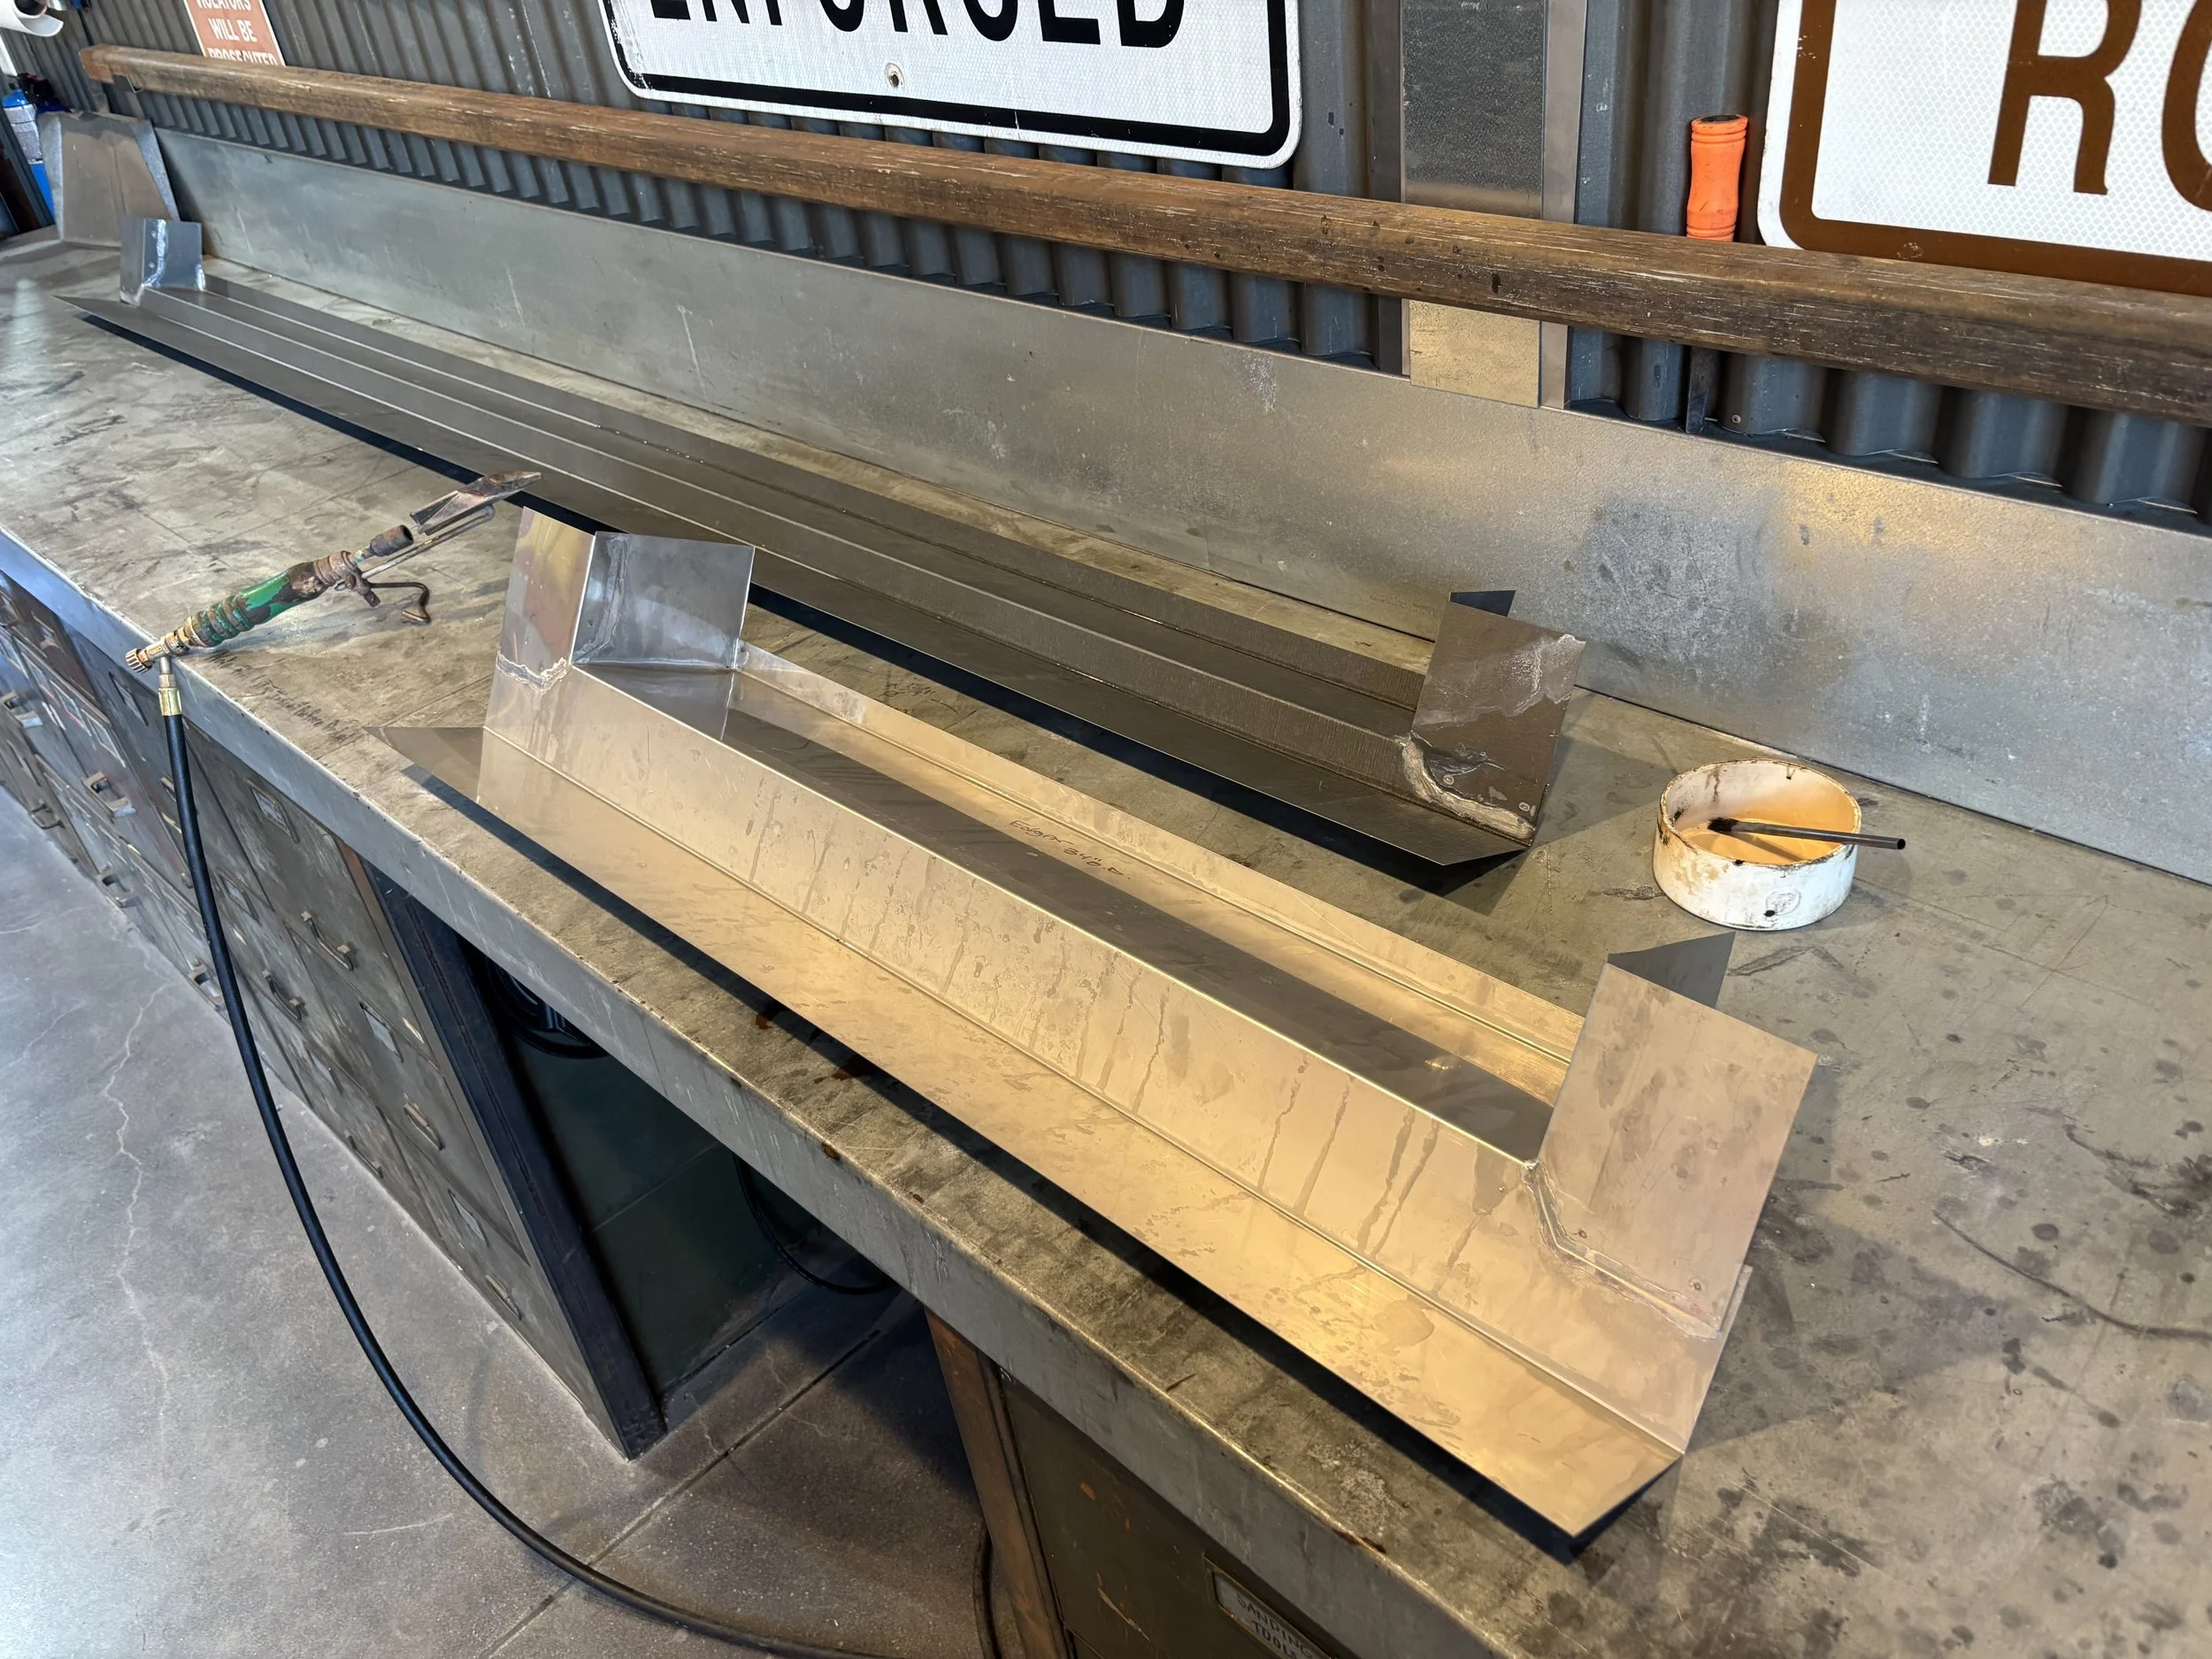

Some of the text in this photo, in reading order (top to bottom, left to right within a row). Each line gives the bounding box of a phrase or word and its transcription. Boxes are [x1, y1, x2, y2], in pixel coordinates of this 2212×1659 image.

[207, 18, 258, 42] WILL BE
[1237, 1594, 1312, 1658] SANDING
